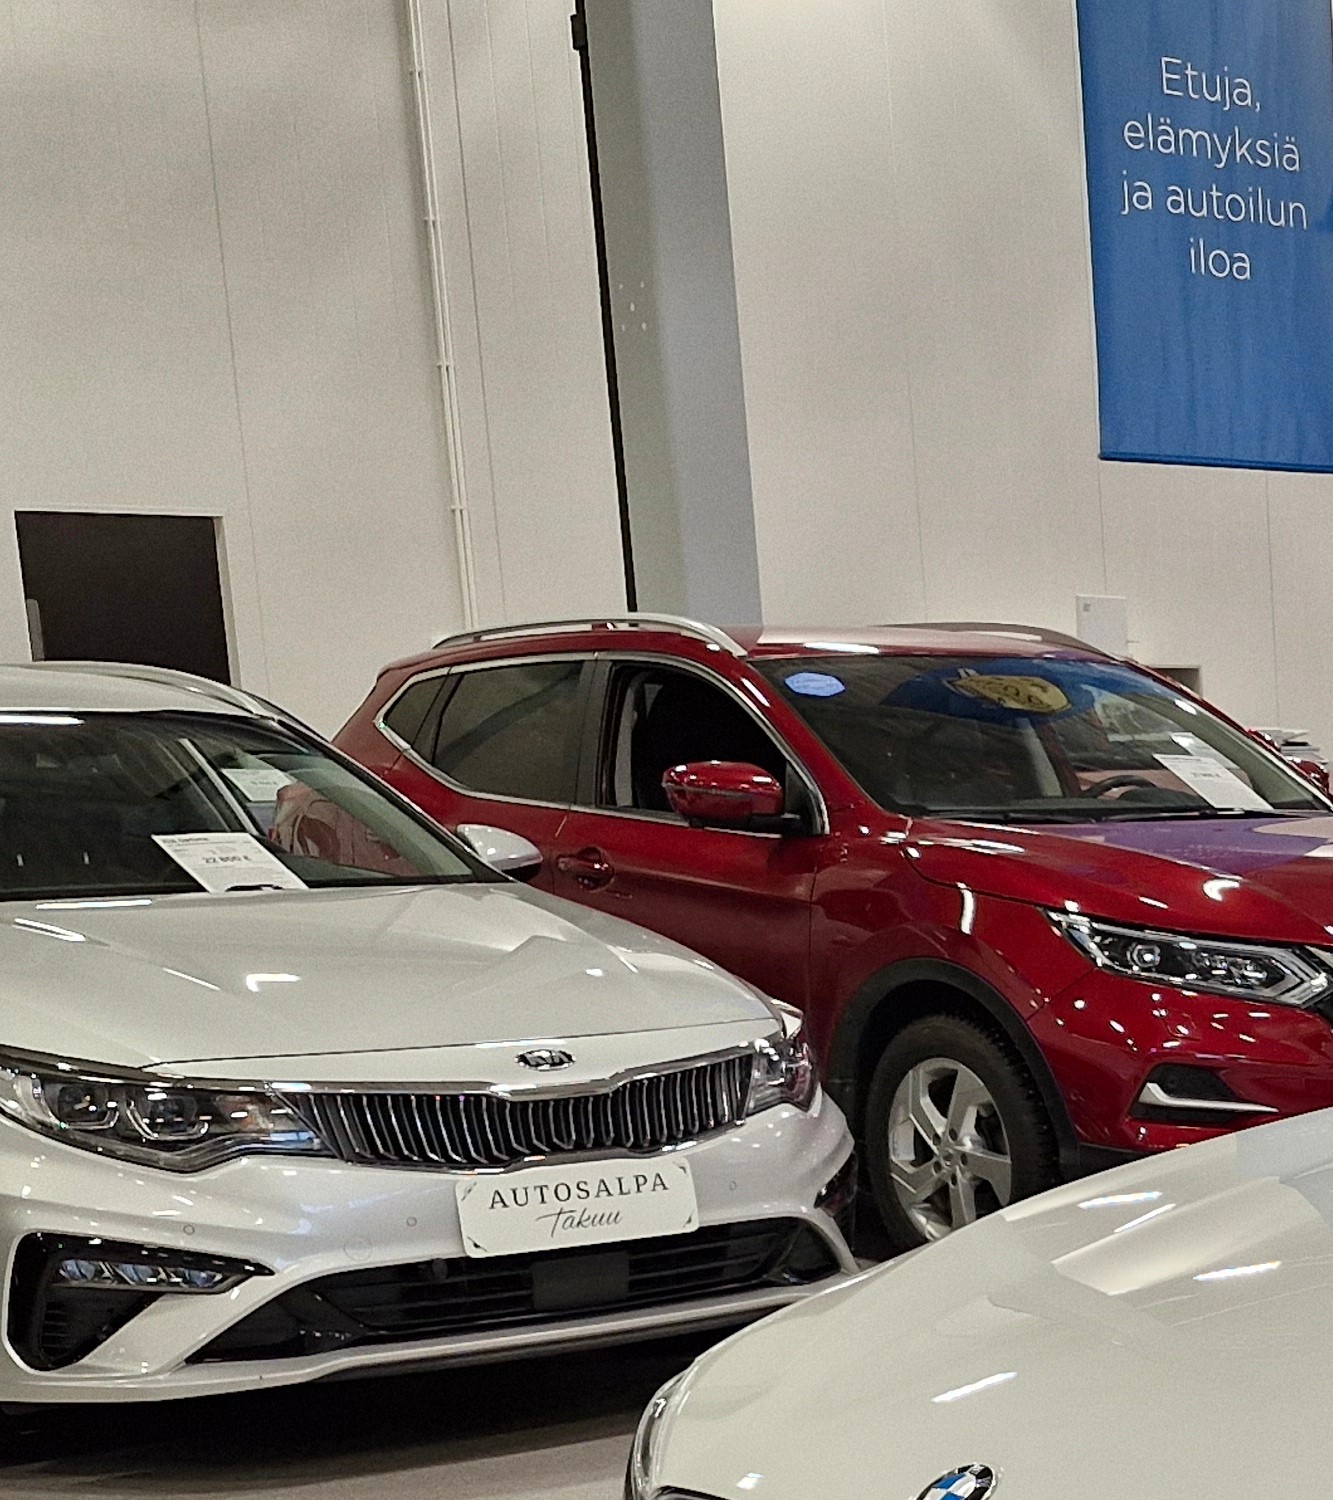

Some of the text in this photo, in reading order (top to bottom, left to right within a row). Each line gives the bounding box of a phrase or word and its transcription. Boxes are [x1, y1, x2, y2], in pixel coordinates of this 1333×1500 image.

[1160, 56, 1261, 113] Etuja,
[1123, 112, 1301, 172] elämyksiä
[1120, 169, 1308, 230] ja autoilun
[1189, 237, 1252, 281] iloa
[488, 1172, 669, 1210] AUTOSALPA
[536, 1207, 623, 1238] Takuu
